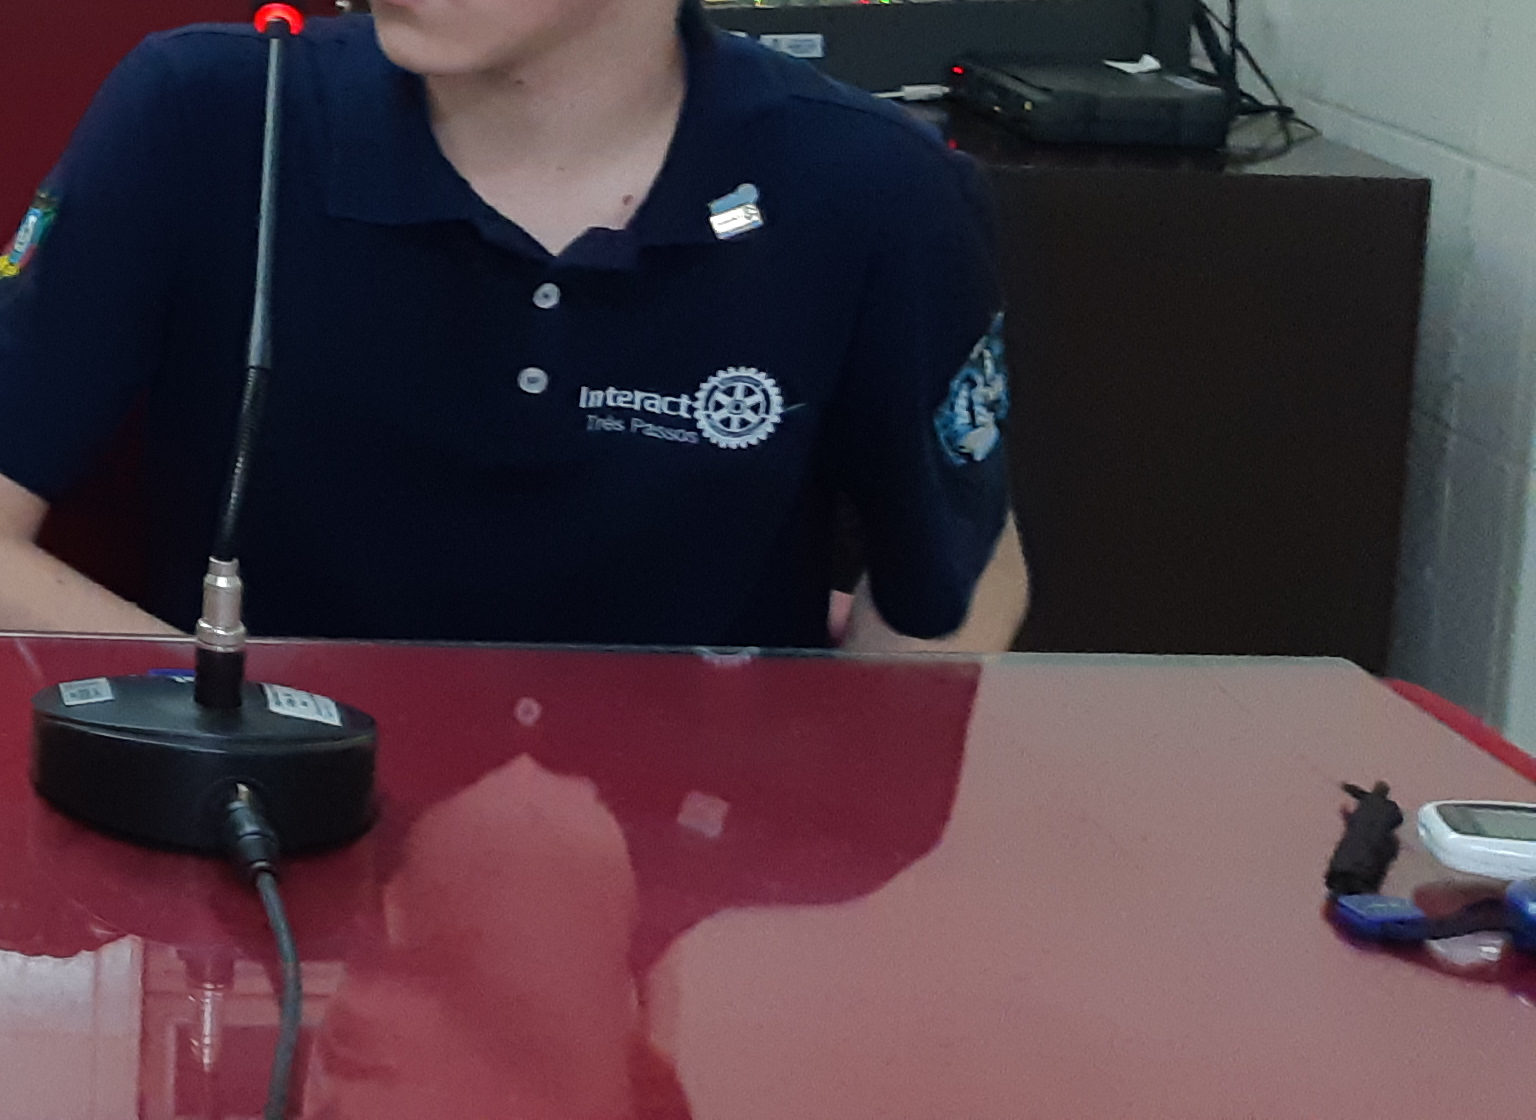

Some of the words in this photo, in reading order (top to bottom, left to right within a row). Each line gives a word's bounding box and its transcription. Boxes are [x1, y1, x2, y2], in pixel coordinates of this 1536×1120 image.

[578, 386, 693, 419] Interact
[586, 414, 626, 432] Três
[630, 417, 700, 444] Passos
